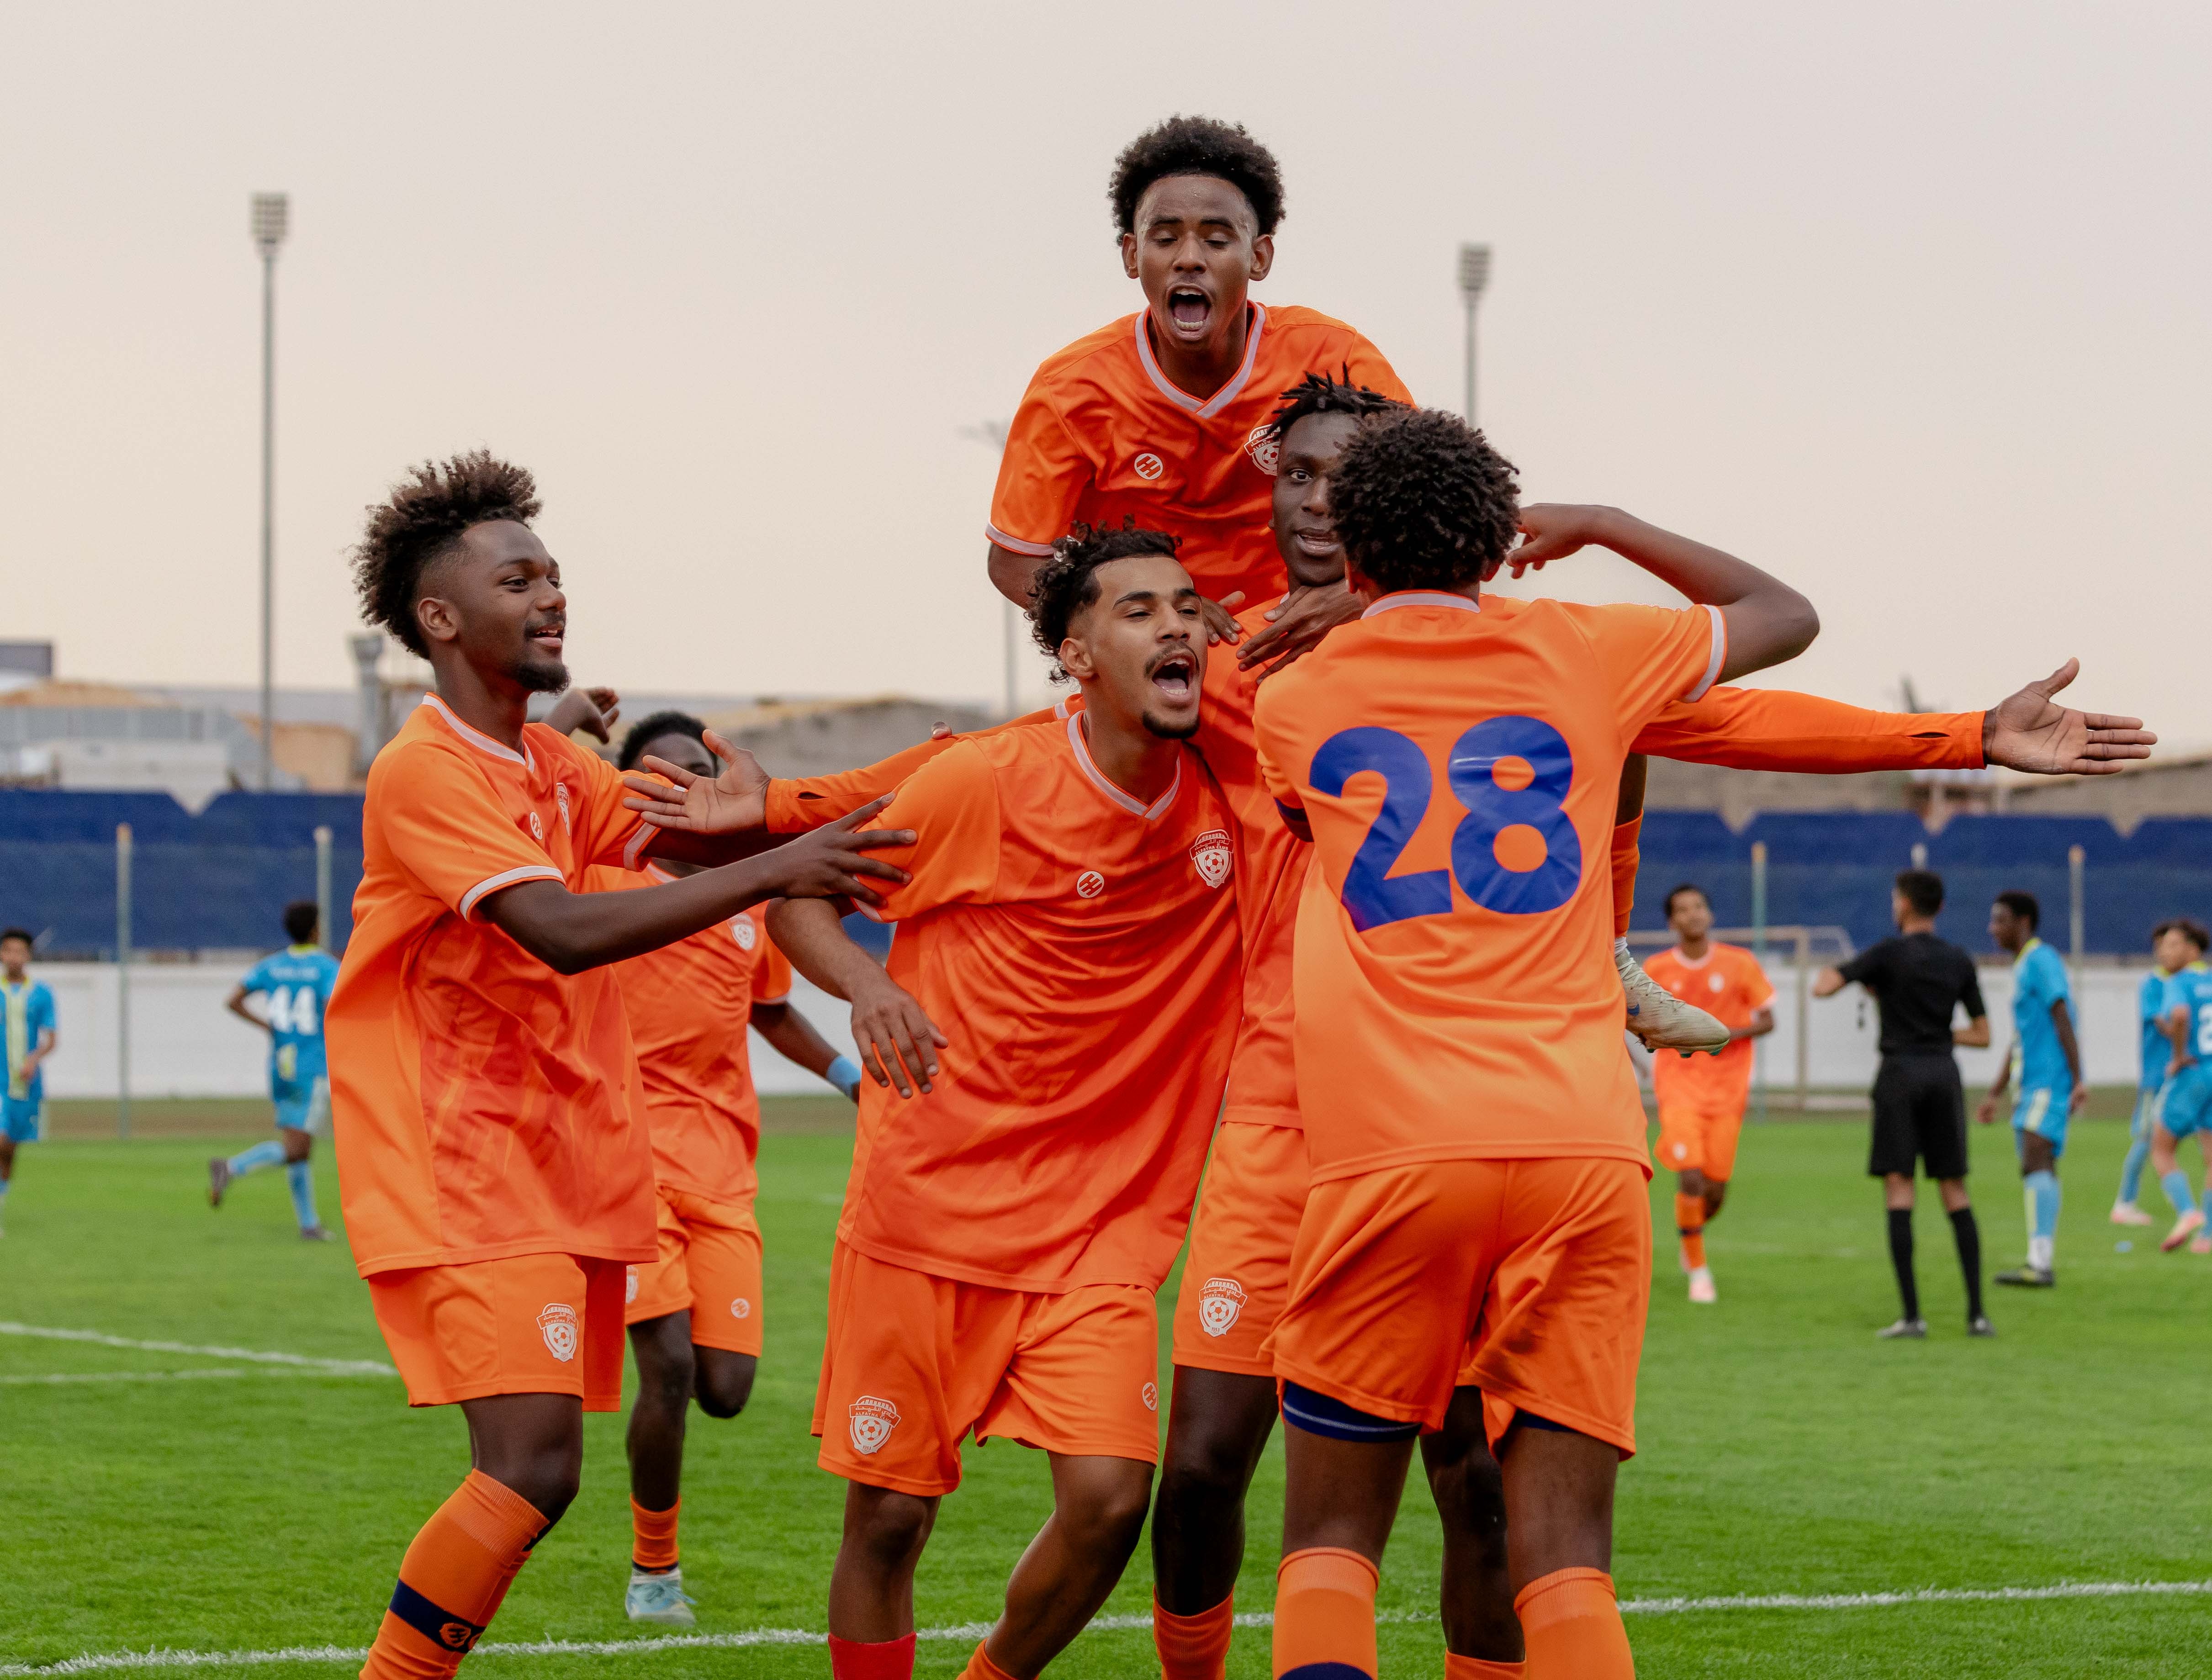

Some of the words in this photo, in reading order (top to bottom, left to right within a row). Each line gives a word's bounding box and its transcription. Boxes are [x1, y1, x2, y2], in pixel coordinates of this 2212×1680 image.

[1253, 440, 1272, 451] ALFAYH
[1309, 715, 1582, 933] 28
[1196, 845, 1215, 855] ALFAYHA
[269, 984, 318, 1035] 44
[880, 1415, 892, 1423] CLUB
